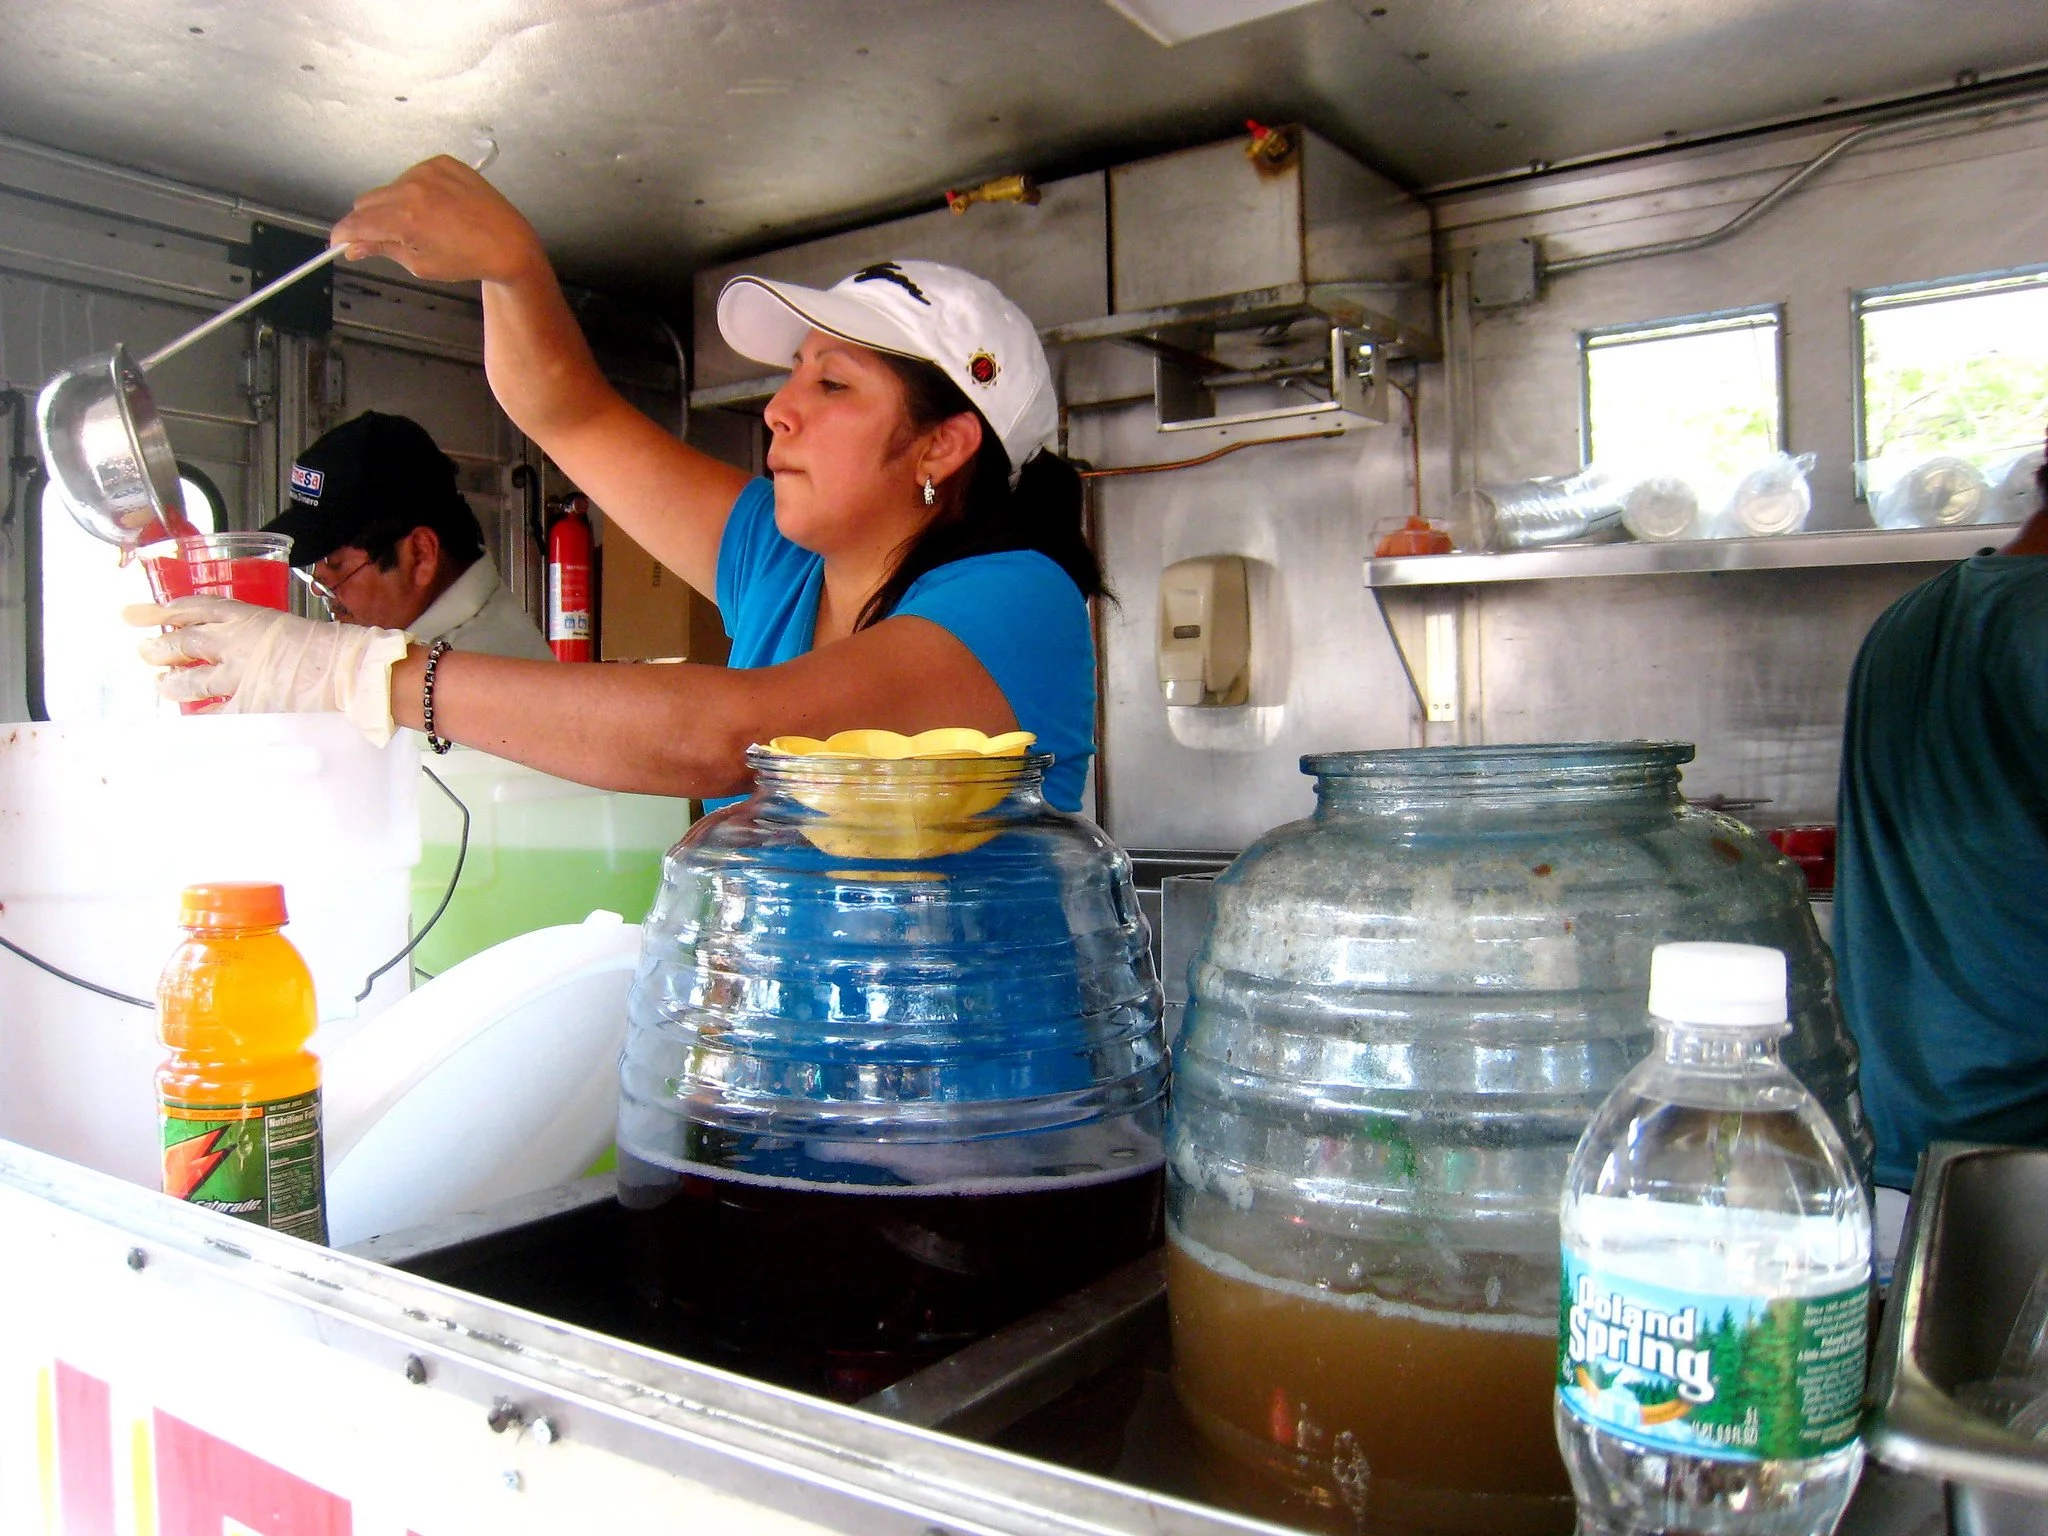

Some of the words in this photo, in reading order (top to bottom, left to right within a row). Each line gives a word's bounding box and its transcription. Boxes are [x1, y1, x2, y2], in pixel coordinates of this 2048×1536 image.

[268, 1112, 304, 1128] Nutrition
[1576, 1273, 1697, 1342] Poland
[1568, 1303, 1715, 1403] Spring
